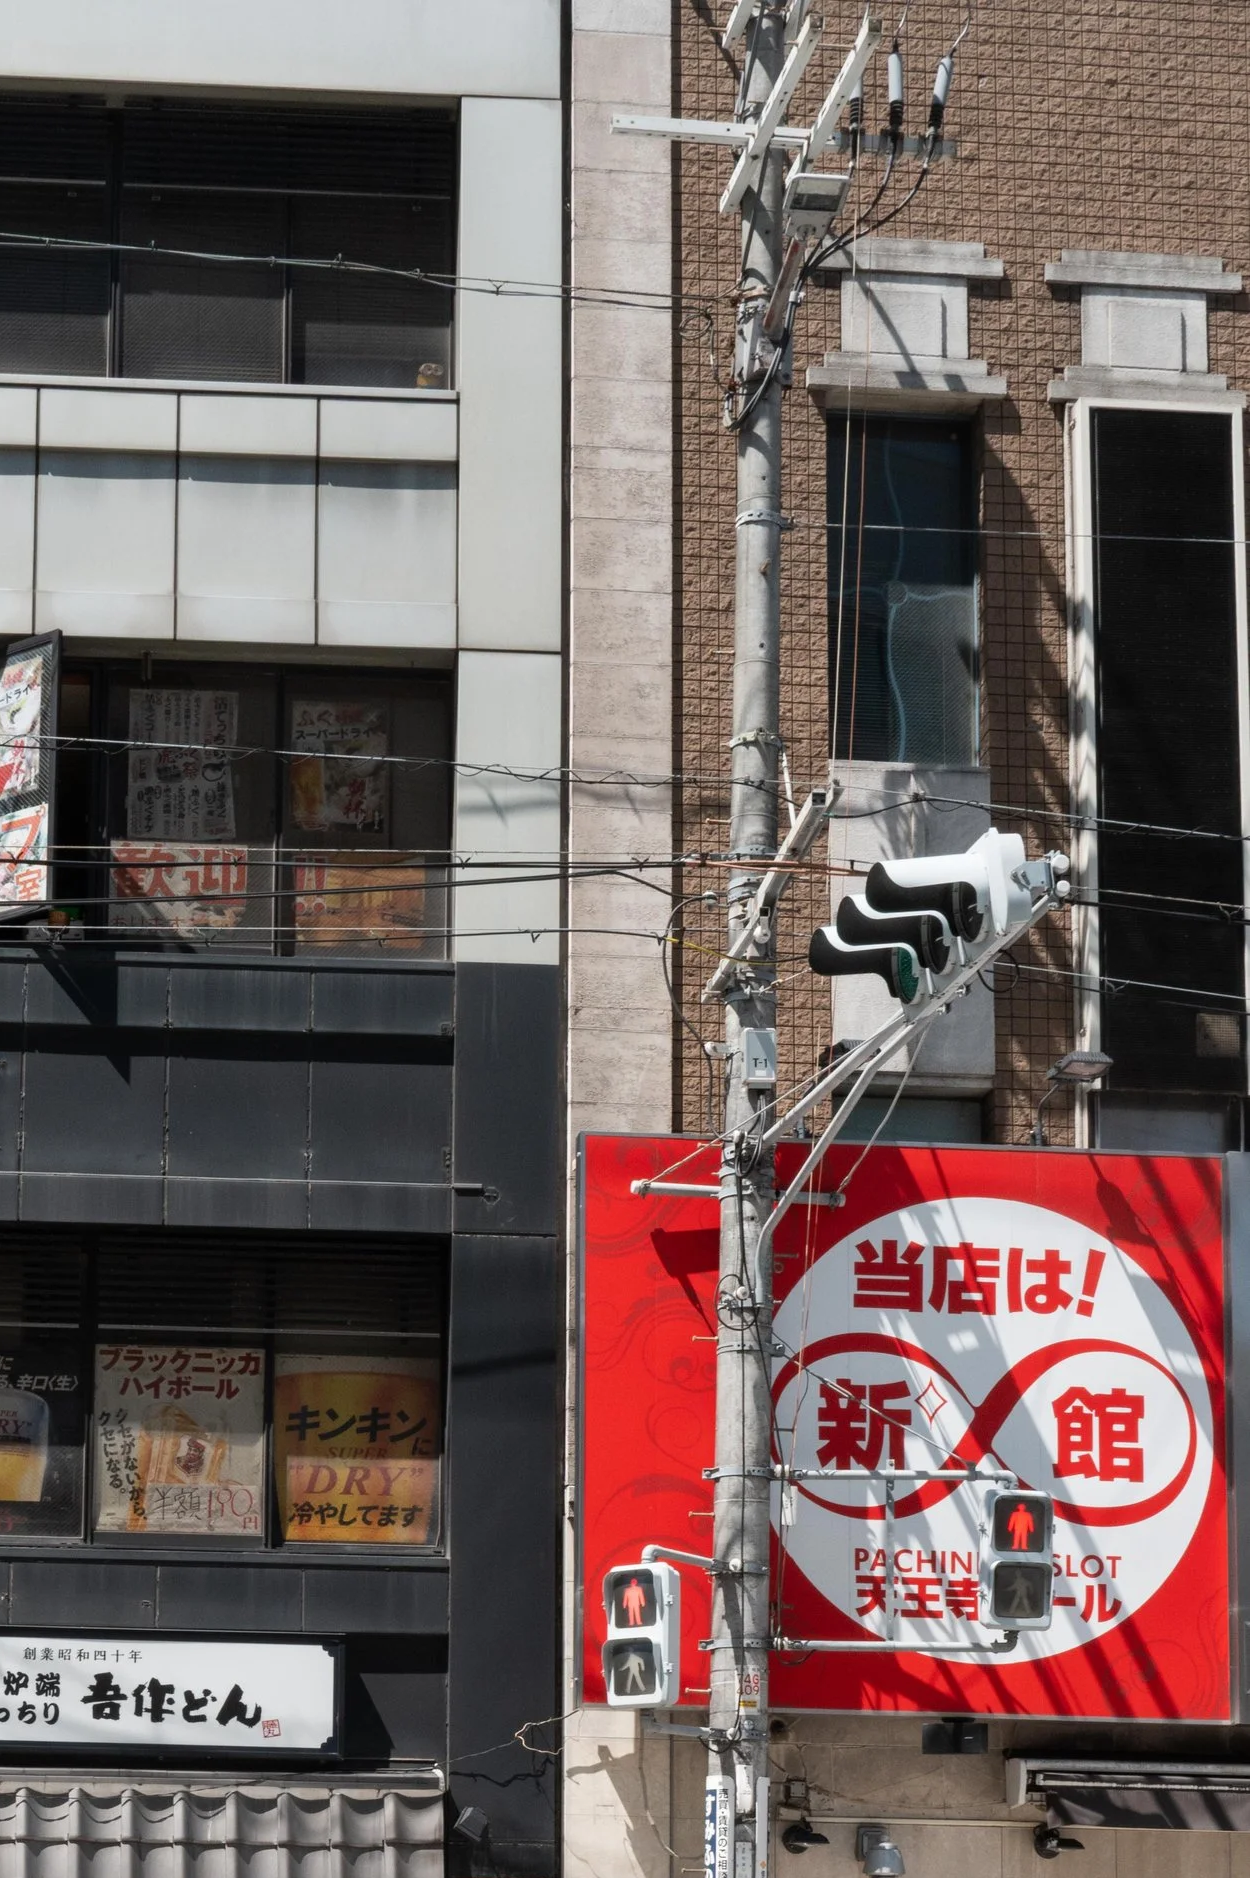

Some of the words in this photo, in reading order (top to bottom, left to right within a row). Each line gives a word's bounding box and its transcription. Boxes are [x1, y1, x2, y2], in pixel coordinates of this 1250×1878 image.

[112, 842, 248, 906] 歓迎
[752, 1057, 768, 1068] T-1
[852, 1240, 1107, 1318] 当店は!
[100, 1350, 261, 1376] ブラックニッカ
[119, 1376, 240, 1400] ハイボール
[325, 1446, 388, 1459] SUPER
[288, 1501, 424, 1528] 冷やしてます
[854, 1548, 980, 1575] PACHIN
[855, 1575, 1122, 1623] 天王寺ール
[23, 1647, 144, 1664] 創業昭和四十年
[81, 1672, 262, 1726] 吾作どん
